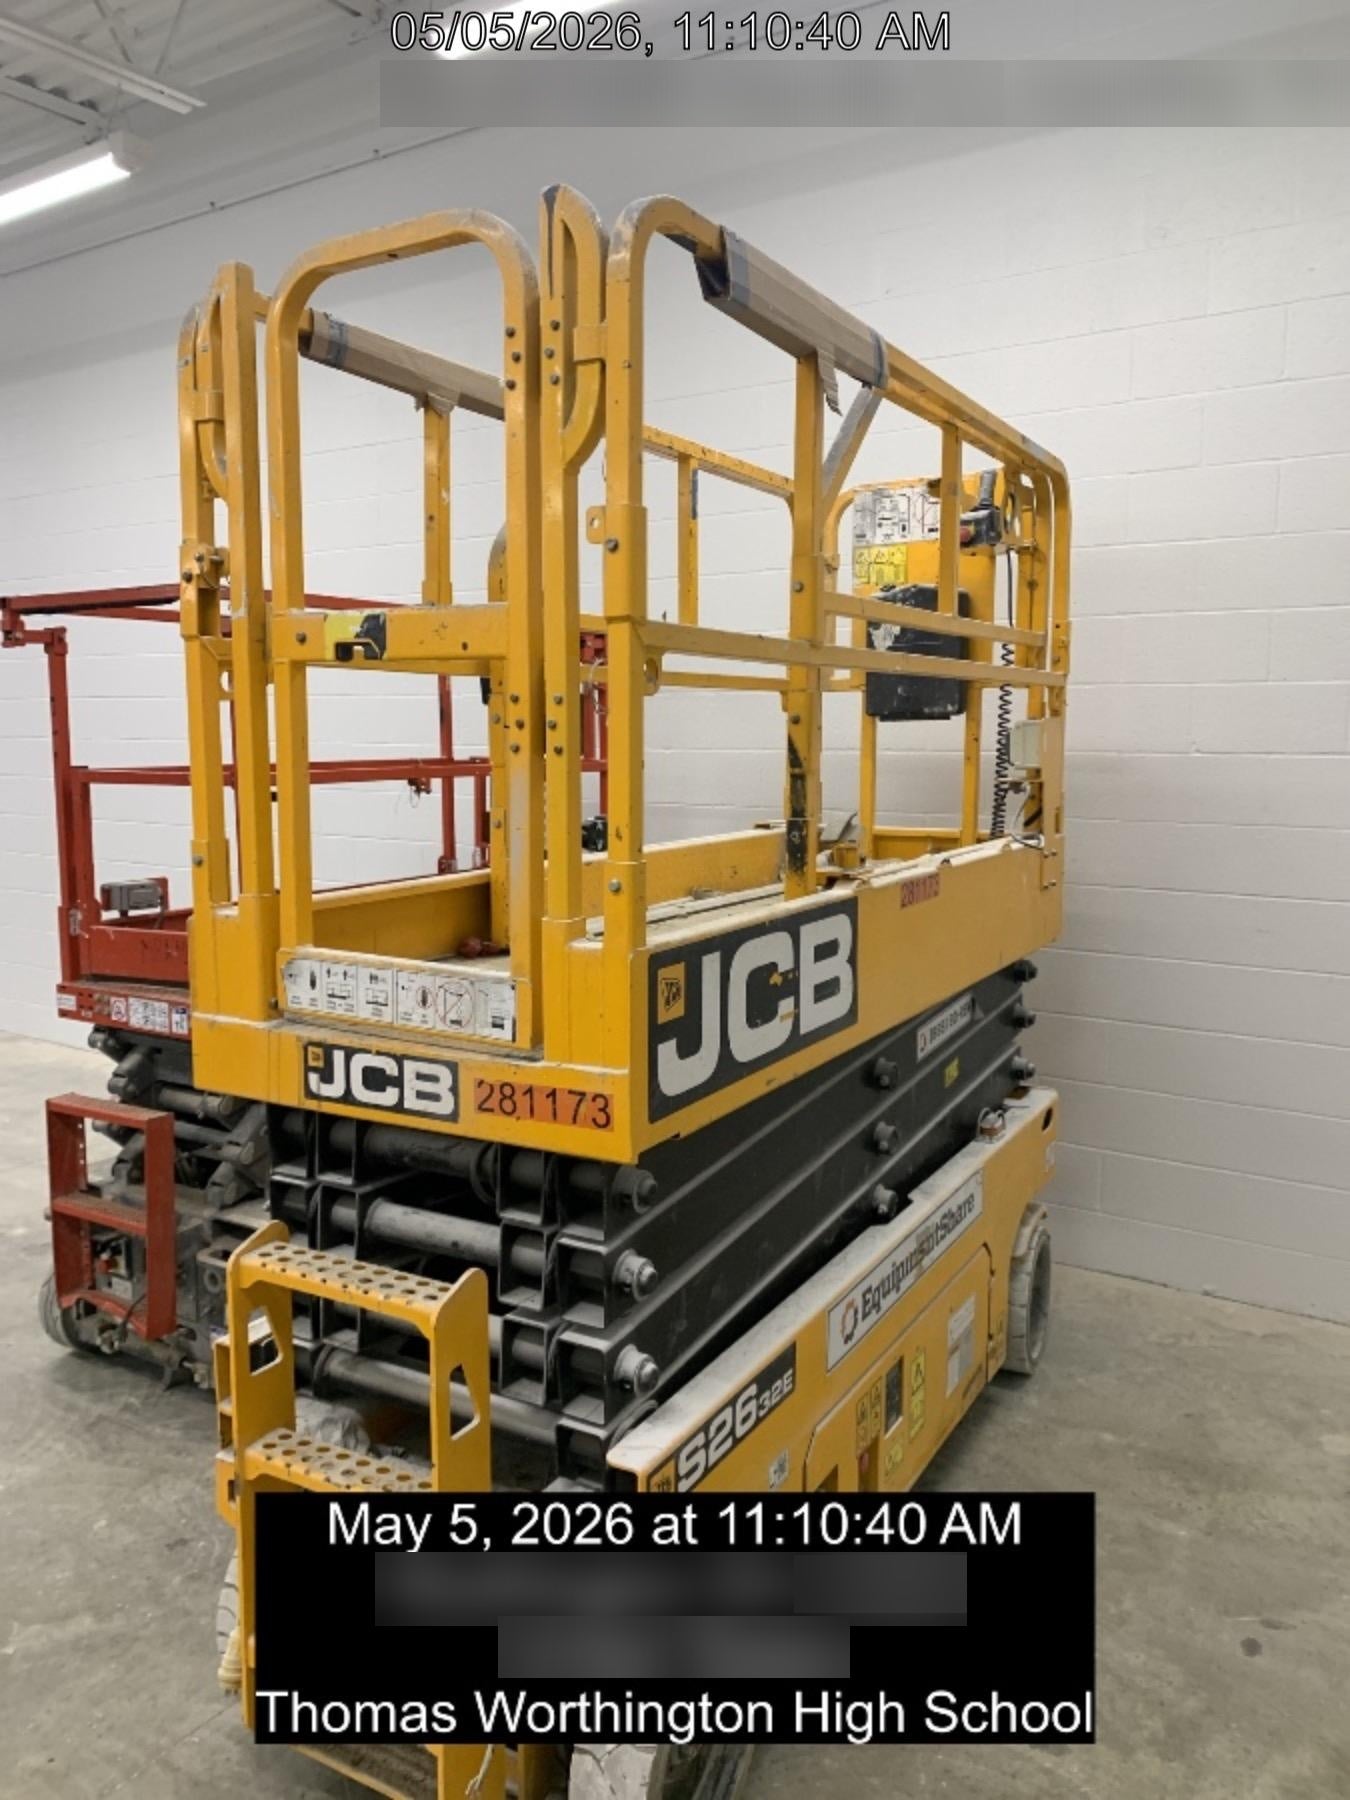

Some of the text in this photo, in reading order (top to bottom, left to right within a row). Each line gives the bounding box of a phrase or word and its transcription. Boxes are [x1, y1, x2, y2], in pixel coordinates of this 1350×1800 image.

[657, 913, 854, 1097] JCB
[308, 1049, 456, 1116] JCB
[477, 1078, 612, 1130] 281173
